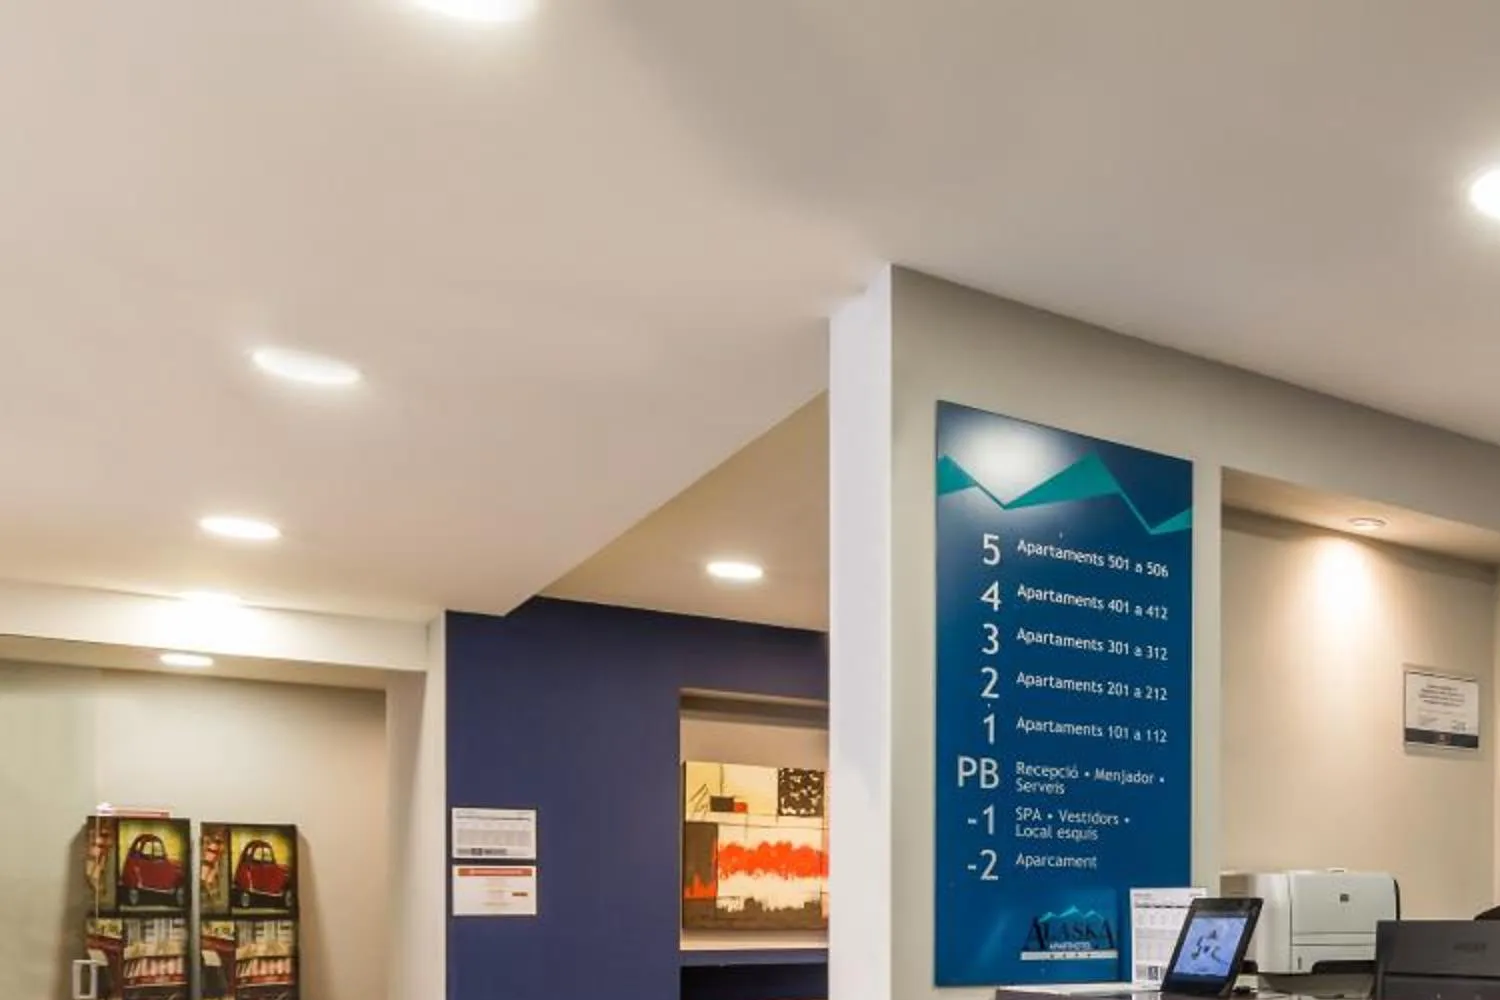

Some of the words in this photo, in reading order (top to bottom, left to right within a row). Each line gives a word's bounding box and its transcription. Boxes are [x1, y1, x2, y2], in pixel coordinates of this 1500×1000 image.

[982, 533, 1001, 565] 5
[1017, 540, 1104, 567] Apartaments
[1108, 554, 1129, 571] 501
[1135, 563, 1143, 574] a
[1147, 562, 1169, 578] 506
[980, 581, 1002, 612] 4
[1017, 585, 1104, 612] Apartaments
[1107, 598, 1129, 614] 401
[1135, 605, 1143, 617] a
[1145, 604, 1168, 620] 412
[981, 623, 999, 655] 3
[1016, 627, 1104, 653] Apartaments
[1107, 638, 1129, 655] 301
[1134, 645, 1142, 657] a
[1145, 644, 1168, 660] 312
[980, 666, 999, 699] 2
[1016, 671, 1103, 694] Apartaments
[1107, 681, 1129, 697] 201
[1133, 686, 1142, 698] a
[1144, 685, 1168, 701] 212
[983, 713, 996, 745] 1
[1016, 716, 1103, 738] Apartaments
[1107, 725, 1129, 739] 101
[1133, 731, 1142, 741] a
[1146, 729, 1168, 743] 112
[957, 756, 1000, 789] PB
[1015, 761, 1079, 780] Recepció
[1094, 767, 1154, 785] Menjador
[1015, 777, 1065, 795] Serveis
[1015, 806, 1042, 822] SPA
[1058, 810, 1119, 826] Vestidors
[1015, 824, 1052, 839] Local
[1015, 853, 1097, 869] Aparcament
